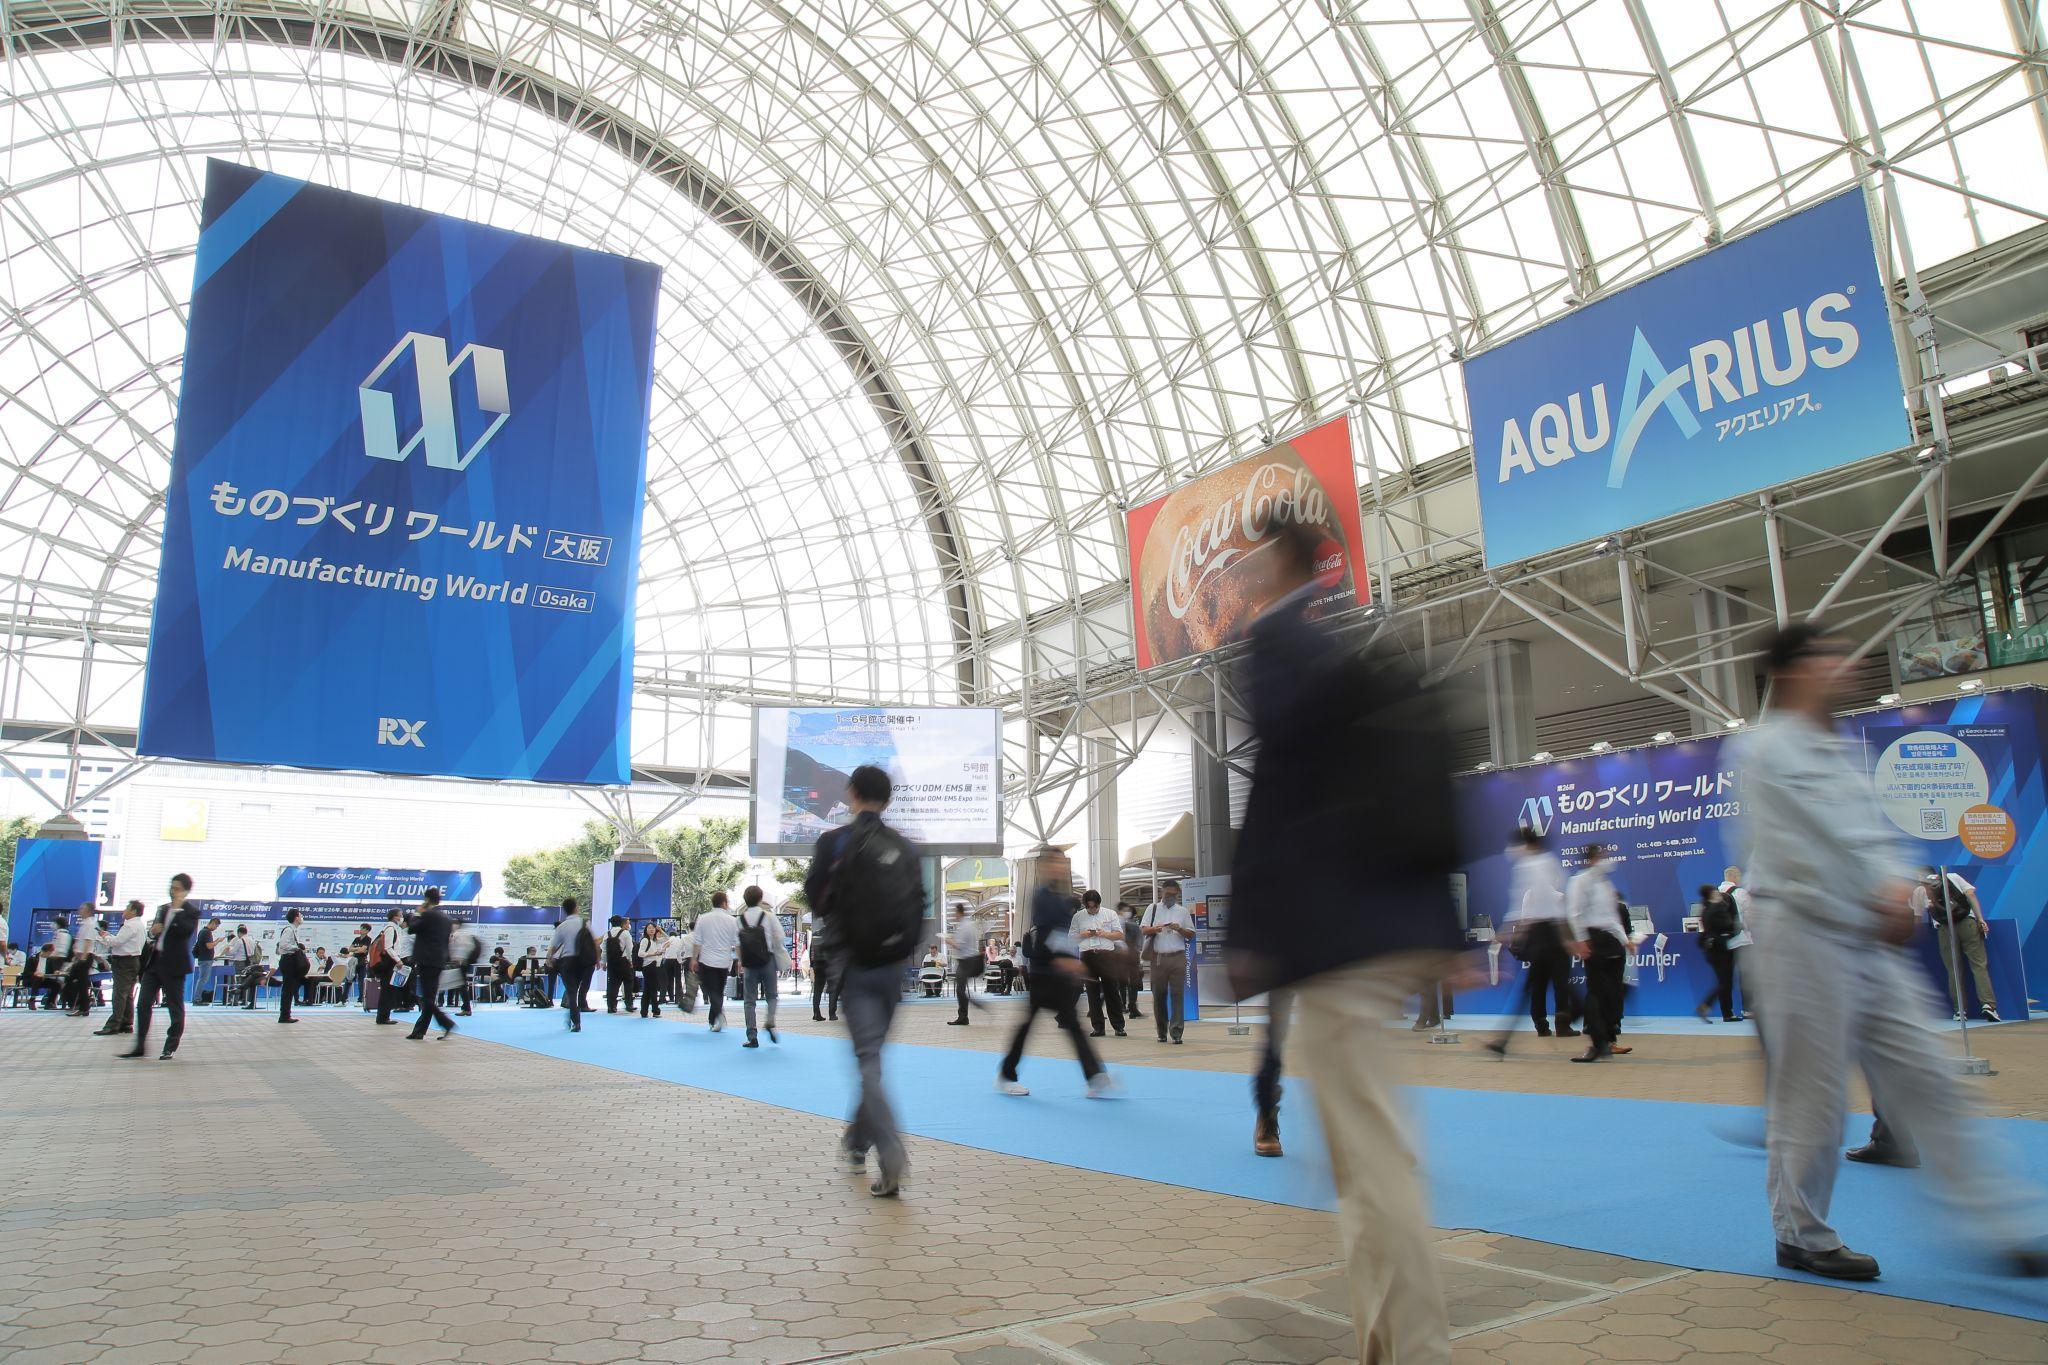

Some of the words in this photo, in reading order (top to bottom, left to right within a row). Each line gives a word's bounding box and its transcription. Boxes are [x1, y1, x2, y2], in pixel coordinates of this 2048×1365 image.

[210, 481, 395, 536] ものづくり
[406, 510, 538, 554] ワールド
[551, 535, 602, 561] 大阪
[223, 546, 438, 601] Manufacturing
[446, 573, 529, 605] World
[539, 590, 587, 609] Osaka
[1308, 598, 1323, 608] TASTE
[1324, 596, 1333, 604] THE
[1334, 588, 1356, 600] FEELING
[378, 717, 427, 748] RX
[963, 762, 989, 773] 5号館
[1558, 783, 1648, 814] ものづくり
[1655, 770, 1735, 802] ワールド
[1561, 813, 1655, 835] Manufacturing
[1658, 805, 1701, 824] World
[1705, 801, 1740, 819] 2023
[1673, 850, 1693, 858] Japan
[1693, 847, 1706, 855] Ltd.
[975, 859, 983, 881] 2
[318, 882, 385, 895] HISTORY
